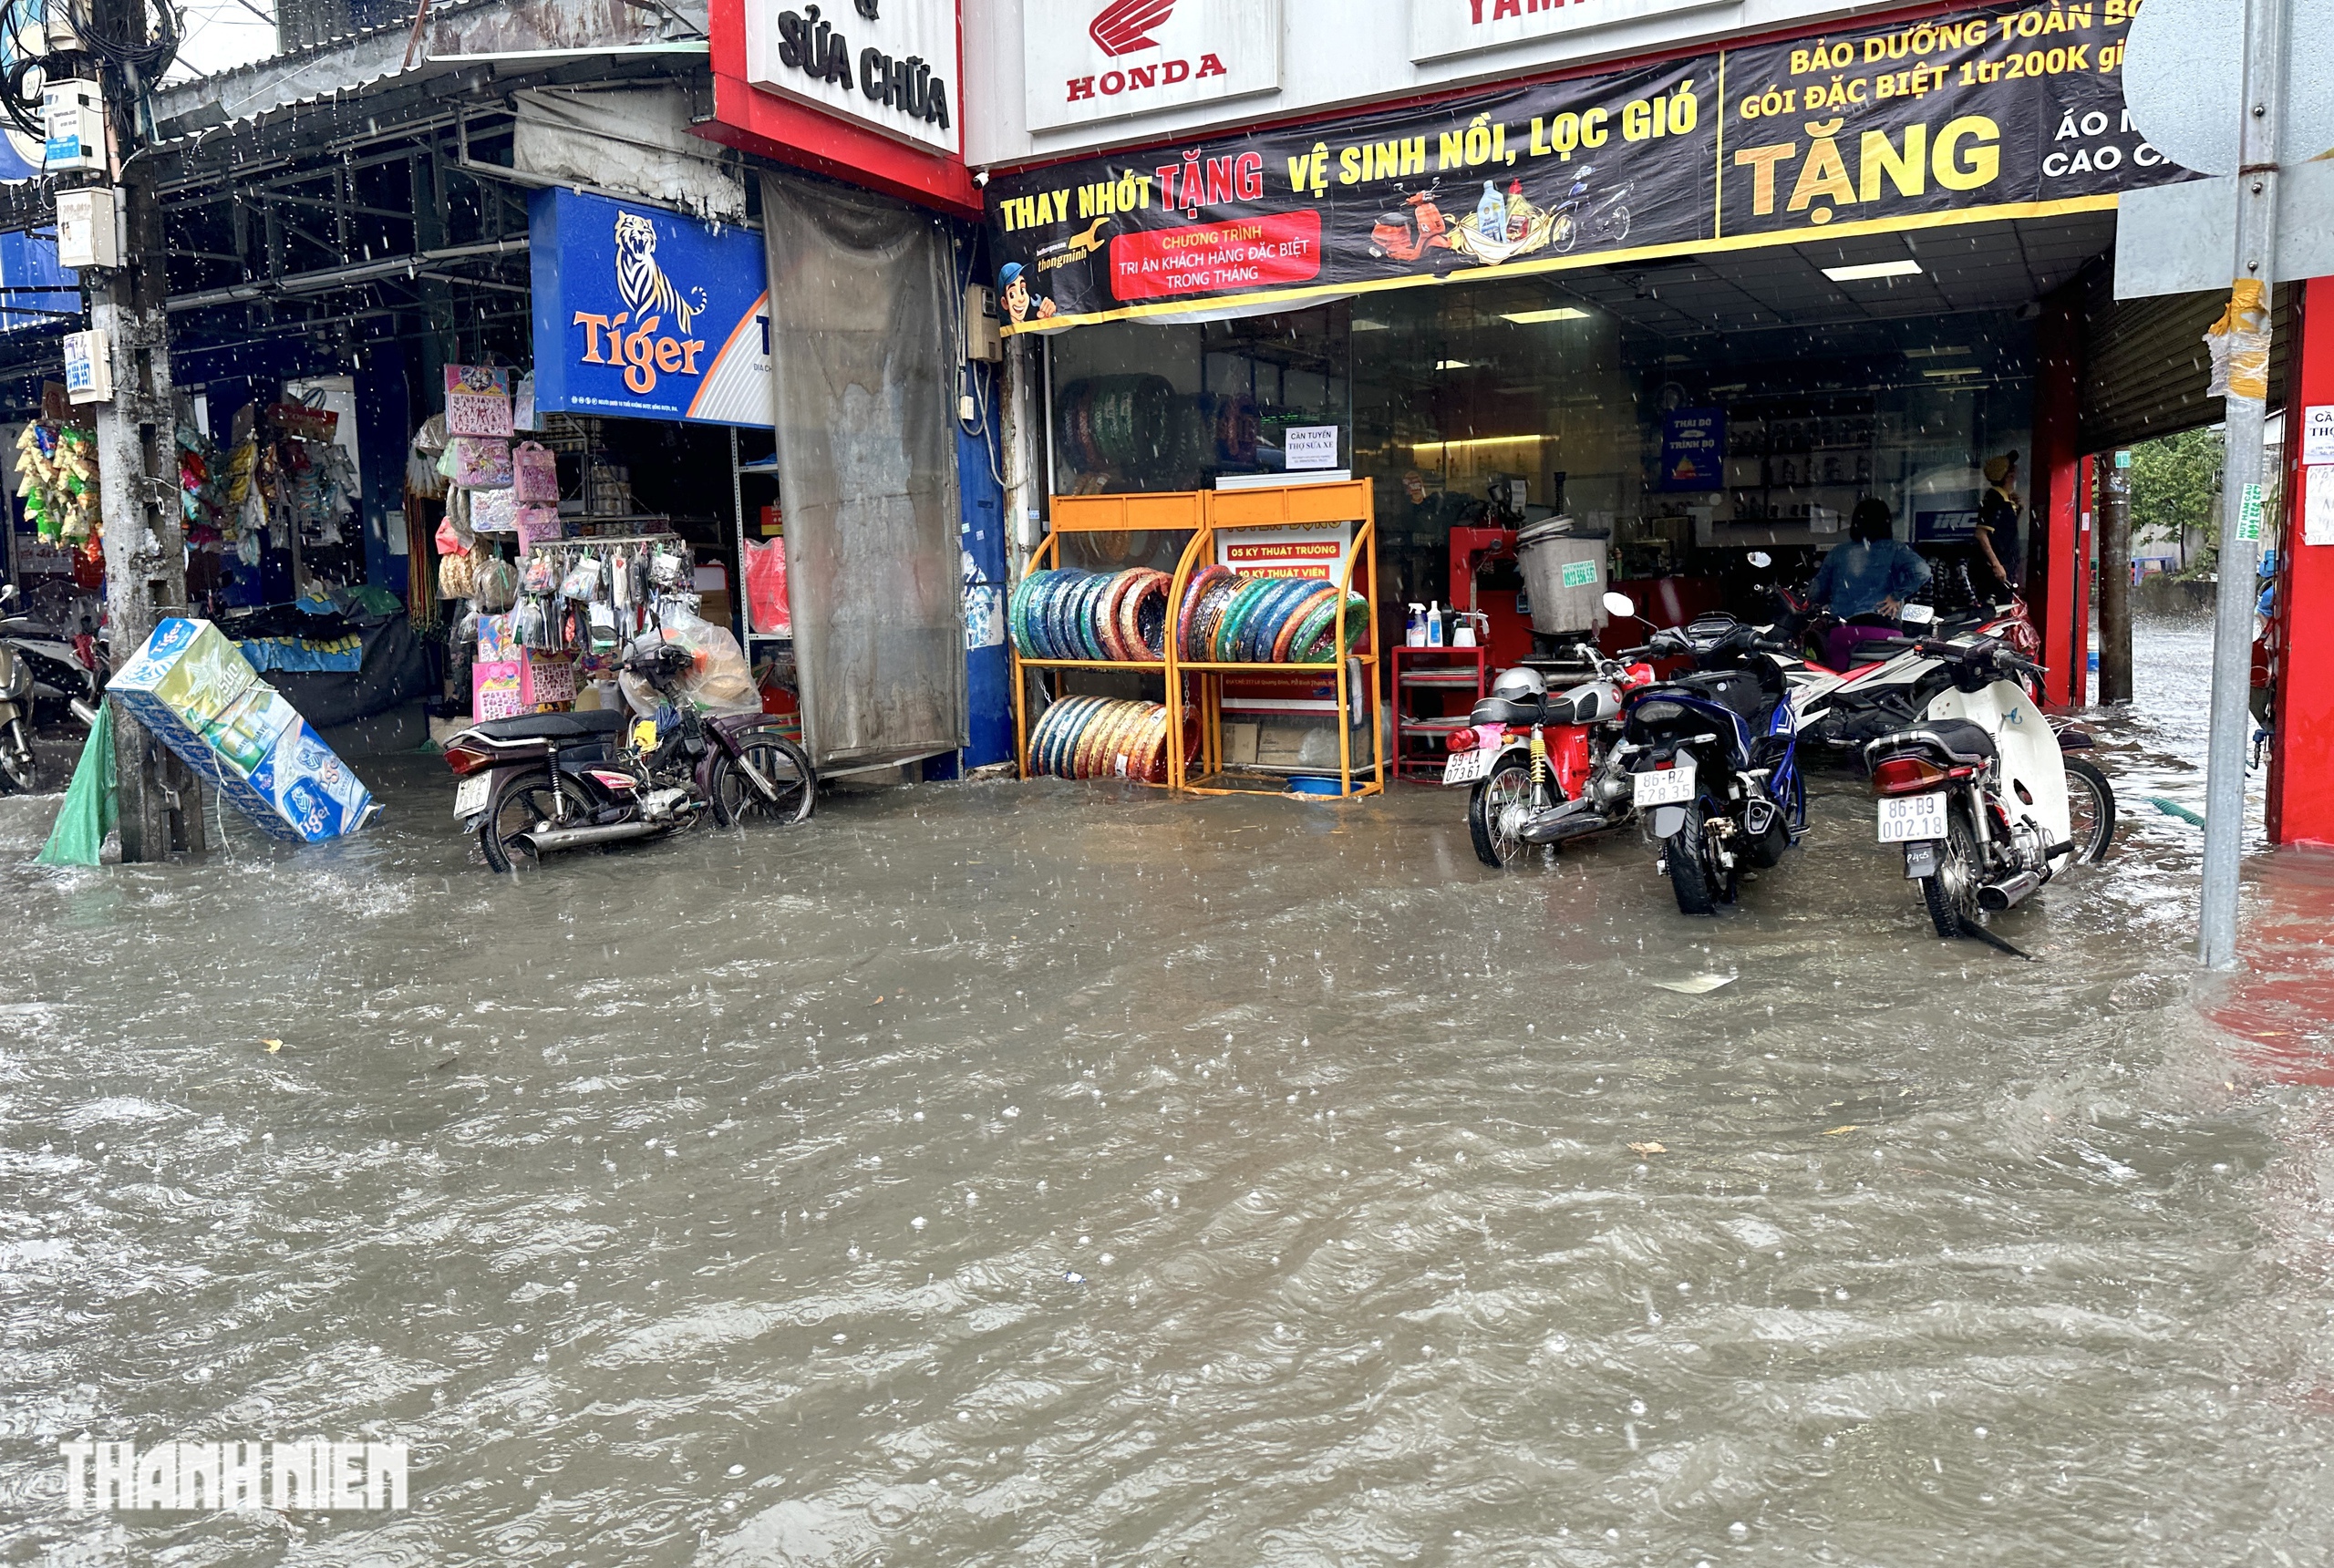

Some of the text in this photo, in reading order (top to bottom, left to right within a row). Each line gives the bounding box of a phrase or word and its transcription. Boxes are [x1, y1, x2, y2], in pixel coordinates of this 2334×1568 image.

[1790, 38, 1854, 75] BẢO
[1864, 19, 1987, 61] DƯỠNG
[2002, 0, 2091, 41] TOÀN
[778, 4, 950, 129] SỬA CHỮA
[1067, 53, 1227, 102] HONDA
[1740, 38, 2125, 119] GÓI ĐẶC BIỆT 1tr200K gi
[1287, 78, 1699, 199] VỆ SINH NỒI, LỌC GIÓ
[2055, 108, 2108, 141] ÁO
[1735, 116, 2000, 224] TẶNG
[2042, 142, 2171, 177] CAO C
[1156, 149, 1264, 220] TẶNG
[1000, 169, 1152, 232] THAY NHỚT
[1162, 225, 1262, 250] CHƯƠNG TRÌNH
[1038, 246, 1087, 273] thongminh
[1120, 236, 1309, 275] TRI ÂN KHÁCH HÀNG ĐẶC BIỆT
[1166, 264, 1258, 289] TRONG THÁNG
[573, 311, 705, 394] Tiger
[1289, 442, 1305, 450] THỢ
[1306, 440, 1321, 449] SỬA
[1291, 429, 1331, 439] CẦN TUYỂN
[1231, 549, 1243, 557] 05
[1245, 547, 1258, 557] KỸ
[1261, 545, 1292, 557] THUẬT
[1302, 567, 1326, 577] VIÊN
[150, 621, 184, 655] Tiger
[1446, 765, 1480, 781] 073.61
[1452, 750, 1480, 767] 59-LA
[1637, 784, 1689, 803] 528.35
[1644, 770, 1684, 788] 86-B2
[1889, 797, 1934, 819] 86-B9
[1884, 816, 1941, 839] 002.18
